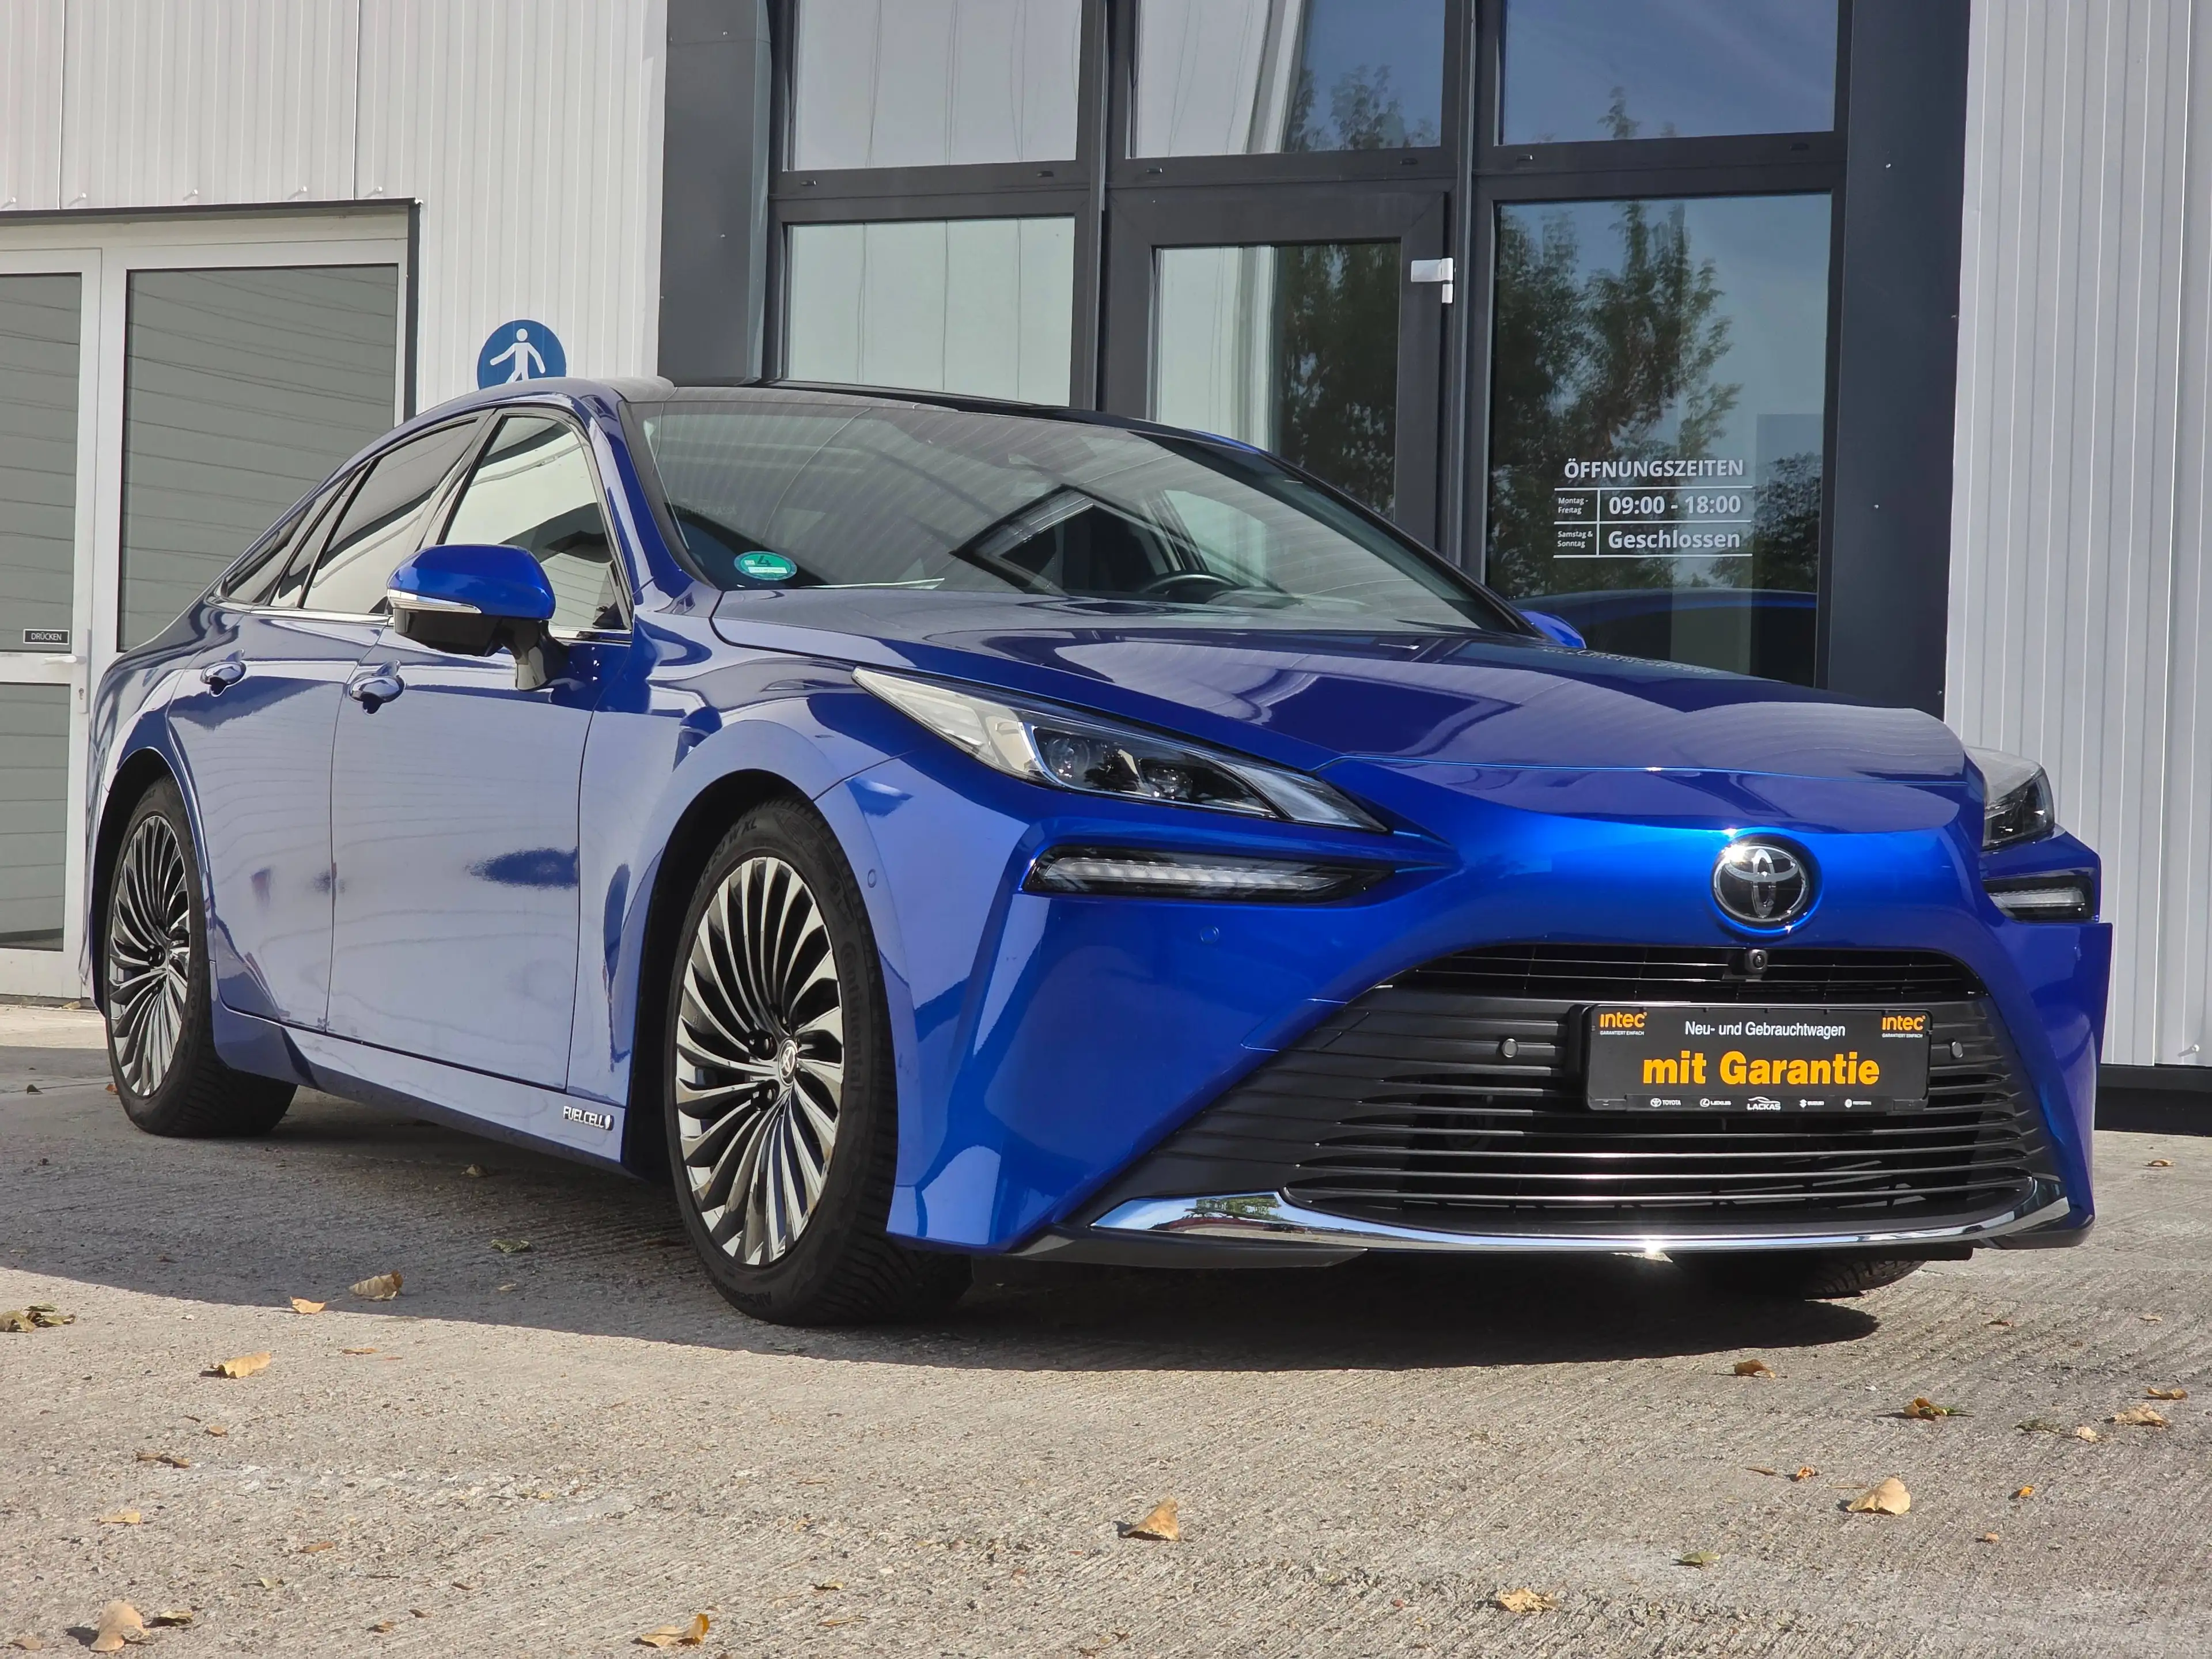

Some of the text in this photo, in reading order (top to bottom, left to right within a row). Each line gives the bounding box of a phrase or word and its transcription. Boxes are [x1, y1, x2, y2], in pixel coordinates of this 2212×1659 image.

[1564, 458, 1744, 479] ÖFFNUNGSZEITEN
[1558, 497, 1584, 505] Montag
[1609, 495, 1665, 515] 09:00
[1685, 495, 1741, 514] 18:00
[1558, 506, 1582, 515] Freitag
[1558, 531, 1586, 539] Samstag
[1608, 530, 1740, 548] Geschlossen
[1557, 540, 1586, 549] Sonntag
[757, 555, 772, 566] 4
[31, 632, 62, 641] DRÜCKEN
[1600, 1012, 1647, 1028] intec
[1882, 1015, 1926, 1031] intec
[1684, 1021, 1846, 1040] Neu- und Gebrauchtwagen
[1643, 1050, 1880, 1085] mit Garantie
